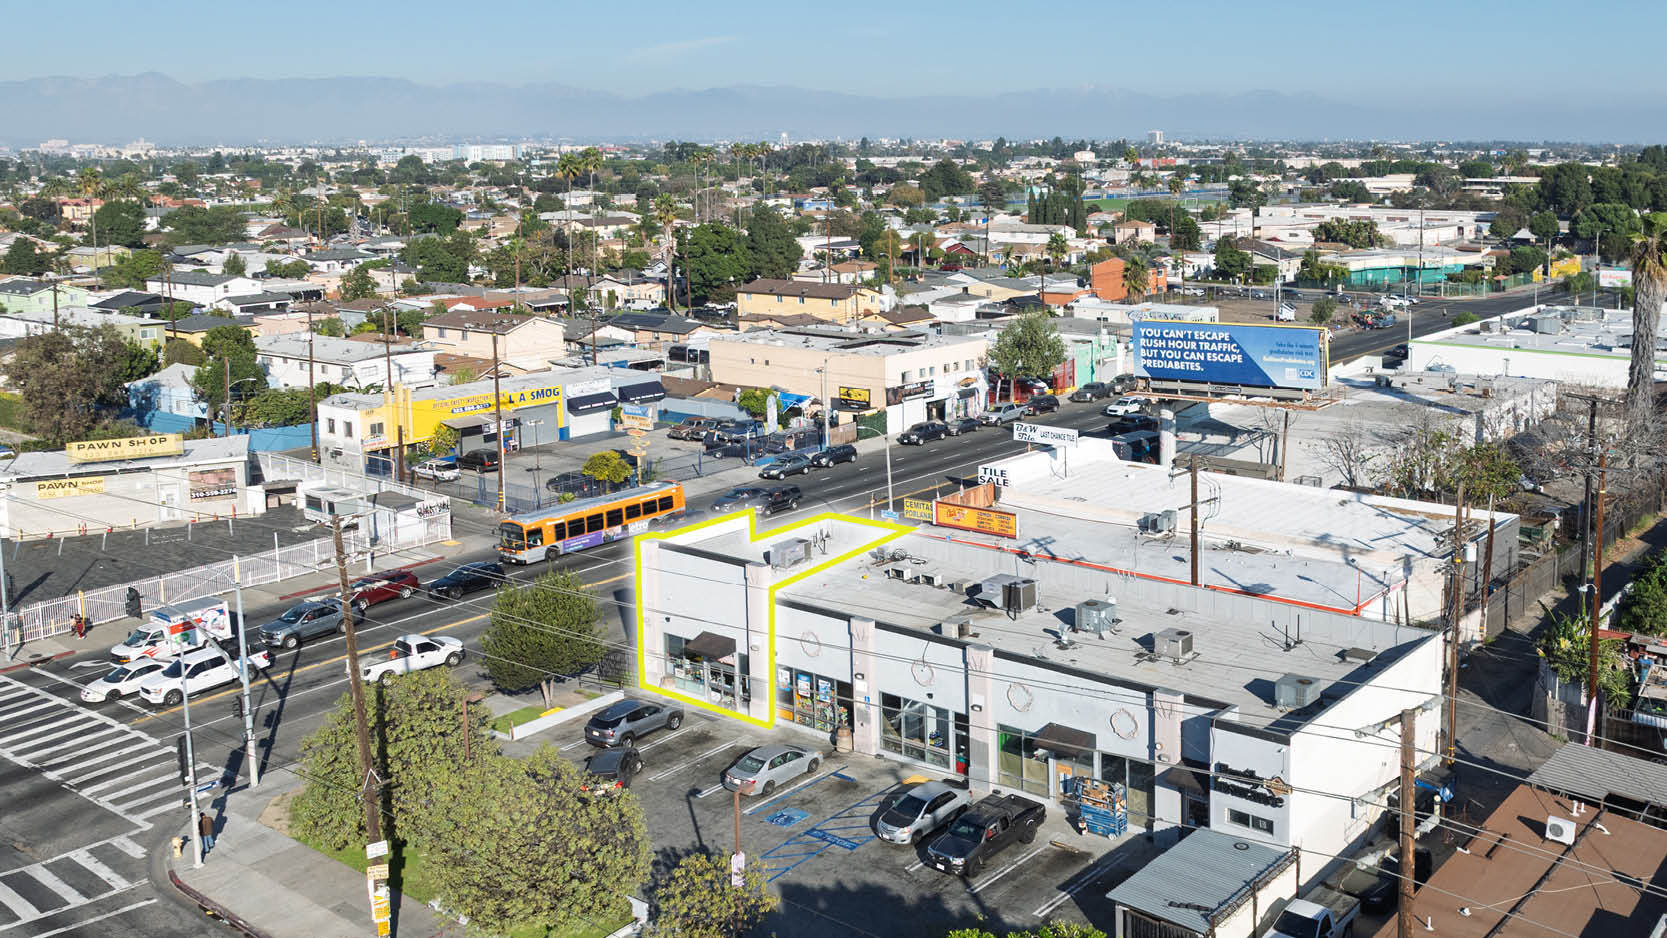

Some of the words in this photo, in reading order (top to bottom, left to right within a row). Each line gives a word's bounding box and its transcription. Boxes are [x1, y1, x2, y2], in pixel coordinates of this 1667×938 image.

[1140, 328, 1160, 337] YOU
[1163, 329, 1192, 339] CAN'T
[1194, 331, 1230, 341] ESCAPE
[1140, 338, 1166, 348] RUSH
[1168, 340, 1197, 350] HOUR
[1199, 341, 1240, 353] TRAFFIC,
[1140, 348, 1158, 358] BUT
[1160, 350, 1181, 360] YOU
[1183, 351, 1205, 361] CAN
[1206, 353, 1243, 363] ESCAPE
[1141, 359, 1204, 371] PREDIABETES.
[530, 387, 560, 400] SMOG
[1016, 423, 1038, 433] B&W
[77, 442, 121, 451] PAWN
[128, 437, 167, 447] SHOP
[982, 467, 1007, 478] TILE
[38, 481, 78, 491] PAWN
[979, 475, 1009, 487] SALE
